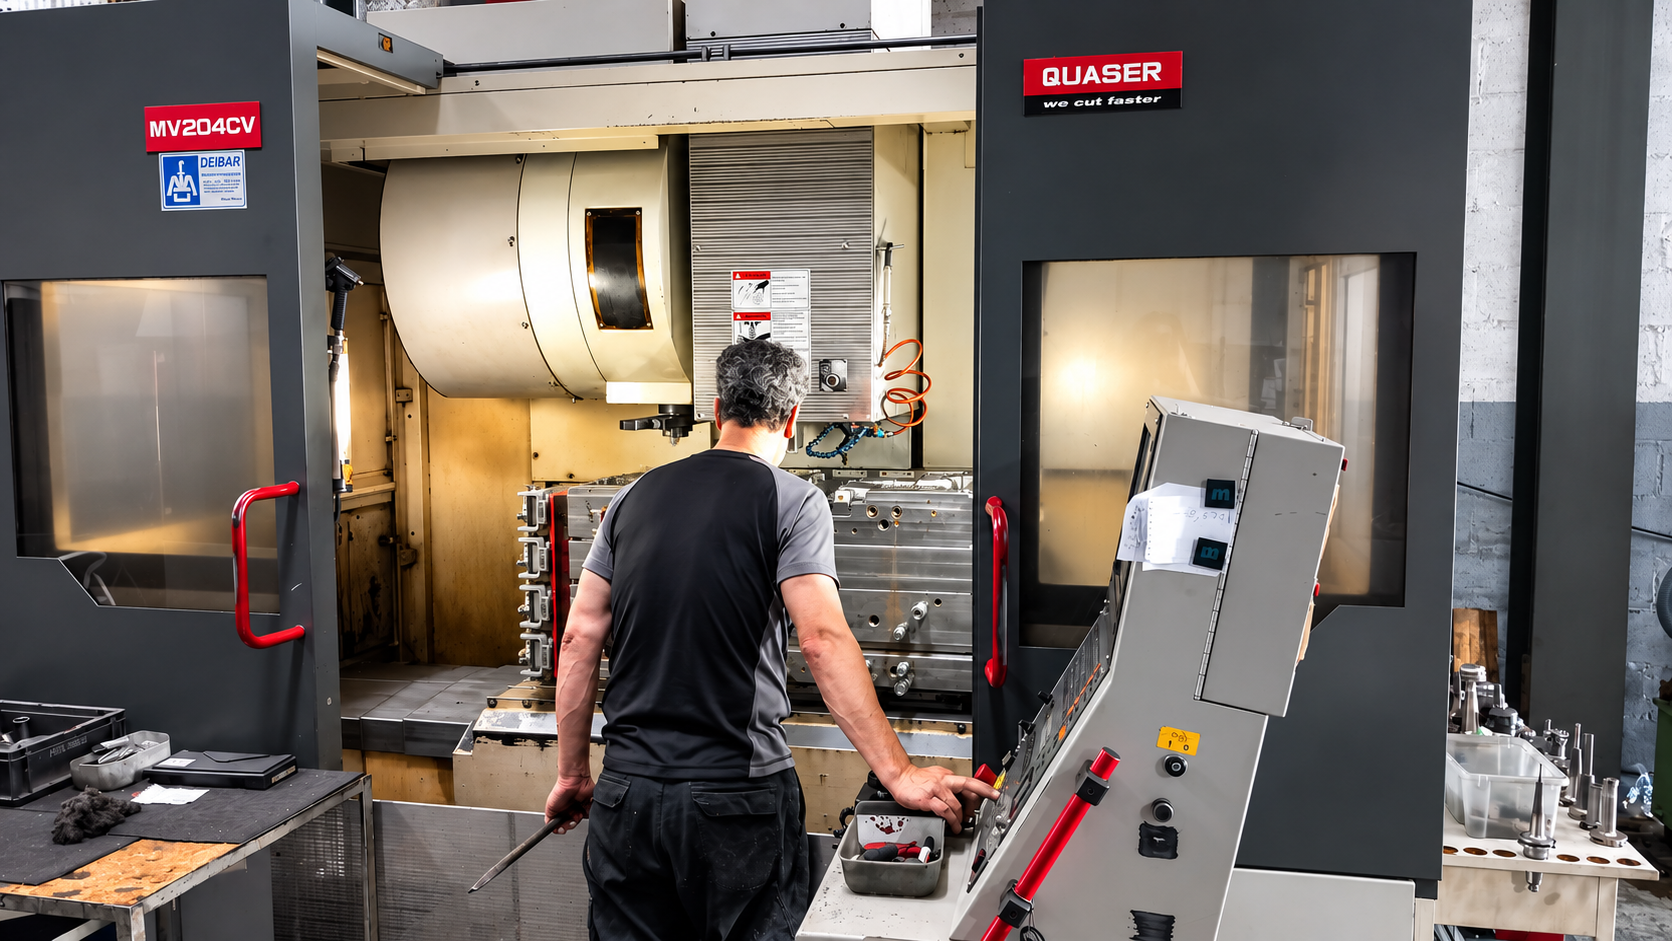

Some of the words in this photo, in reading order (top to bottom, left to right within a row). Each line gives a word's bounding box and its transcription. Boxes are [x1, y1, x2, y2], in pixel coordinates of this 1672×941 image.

[1042, 62, 1162, 87] QUASER
[1043, 100, 1068, 108] we
[1073, 97, 1103, 107] cut
[1107, 94, 1162, 106] faster
[149, 116, 256, 138] MV204CV
[200, 155, 241, 169] DEIBAR
